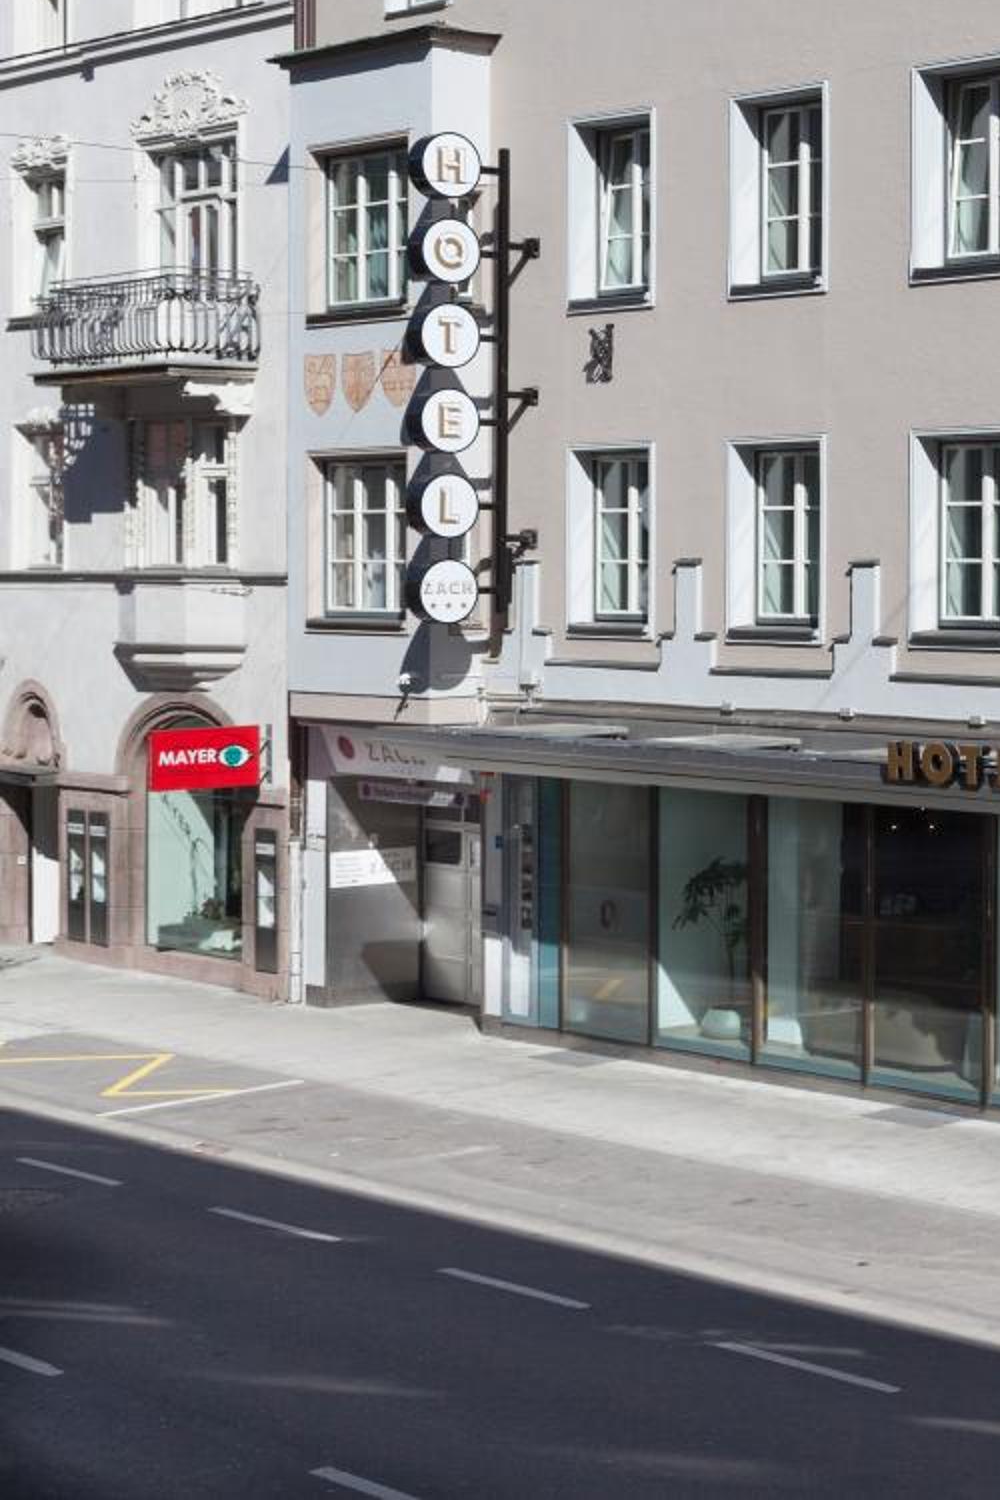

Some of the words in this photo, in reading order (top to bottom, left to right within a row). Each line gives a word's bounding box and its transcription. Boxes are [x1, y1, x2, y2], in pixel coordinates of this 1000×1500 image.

[432, 146, 466, 525] HOTEL
[423, 582, 475, 595] ZACH
[158, 748, 217, 766] MAYER
[366, 742, 426, 765] ZAC
